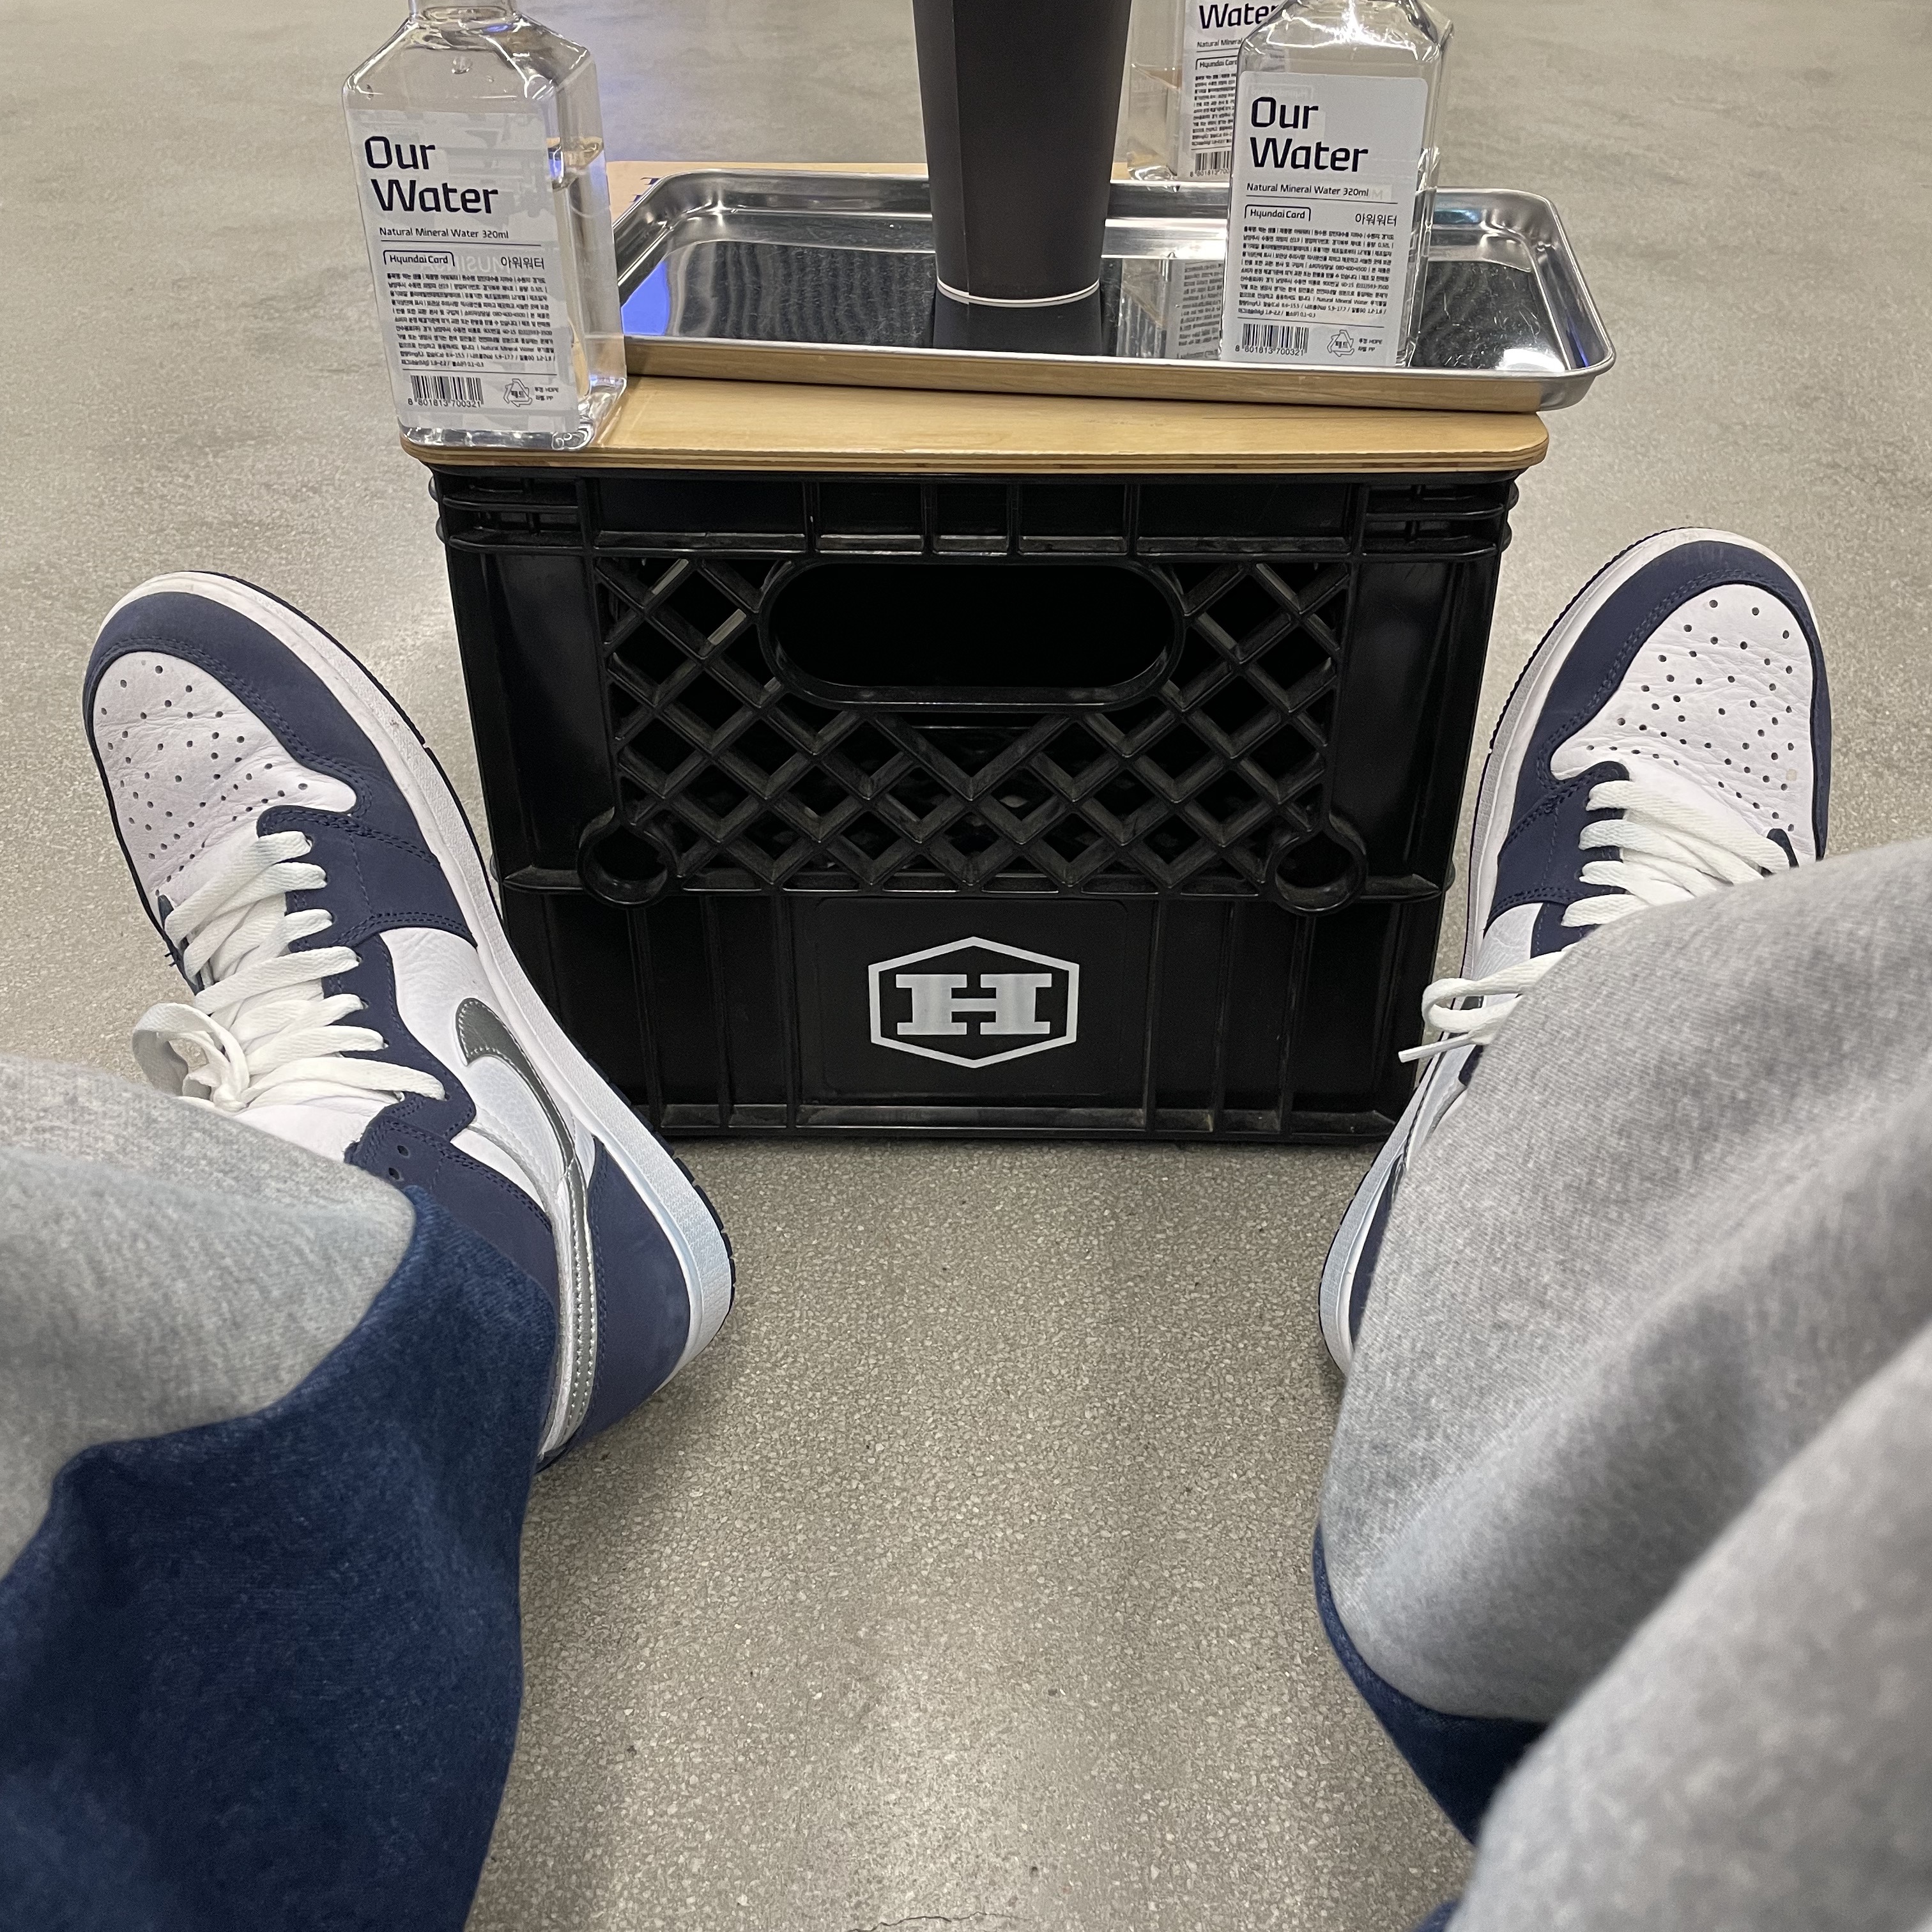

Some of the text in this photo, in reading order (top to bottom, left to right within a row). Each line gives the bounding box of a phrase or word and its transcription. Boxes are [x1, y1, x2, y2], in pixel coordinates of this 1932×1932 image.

[1197, 37, 1243, 48] Natural Mineral
[1199, 59, 1225, 68] Hyundai
[1251, 96, 1319, 129] Our
[364, 135, 436, 169] Our
[1250, 137, 1368, 172] Water
[370, 178, 499, 213] Water
[1246, 183, 1278, 192] Natural
[1280, 184, 1312, 194] Mineral
[1314, 185, 1341, 195] Water
[1343, 187, 1369, 197] 320ml
[1250, 208, 1305, 220] Hyundai Card
[1355, 213, 1398, 227] 아워워터
[379, 227, 509, 239] Natural Mineral Water 320ml
[389, 254, 448, 264] Hyundai Card
[500, 256, 545, 270] 아워워터
[1244, 345, 1274, 354] 801813
[1276, 348, 1305, 356] 700321
[408, 397, 482, 408] 8 801813 700321
[896, 973, 1052, 1035] H
